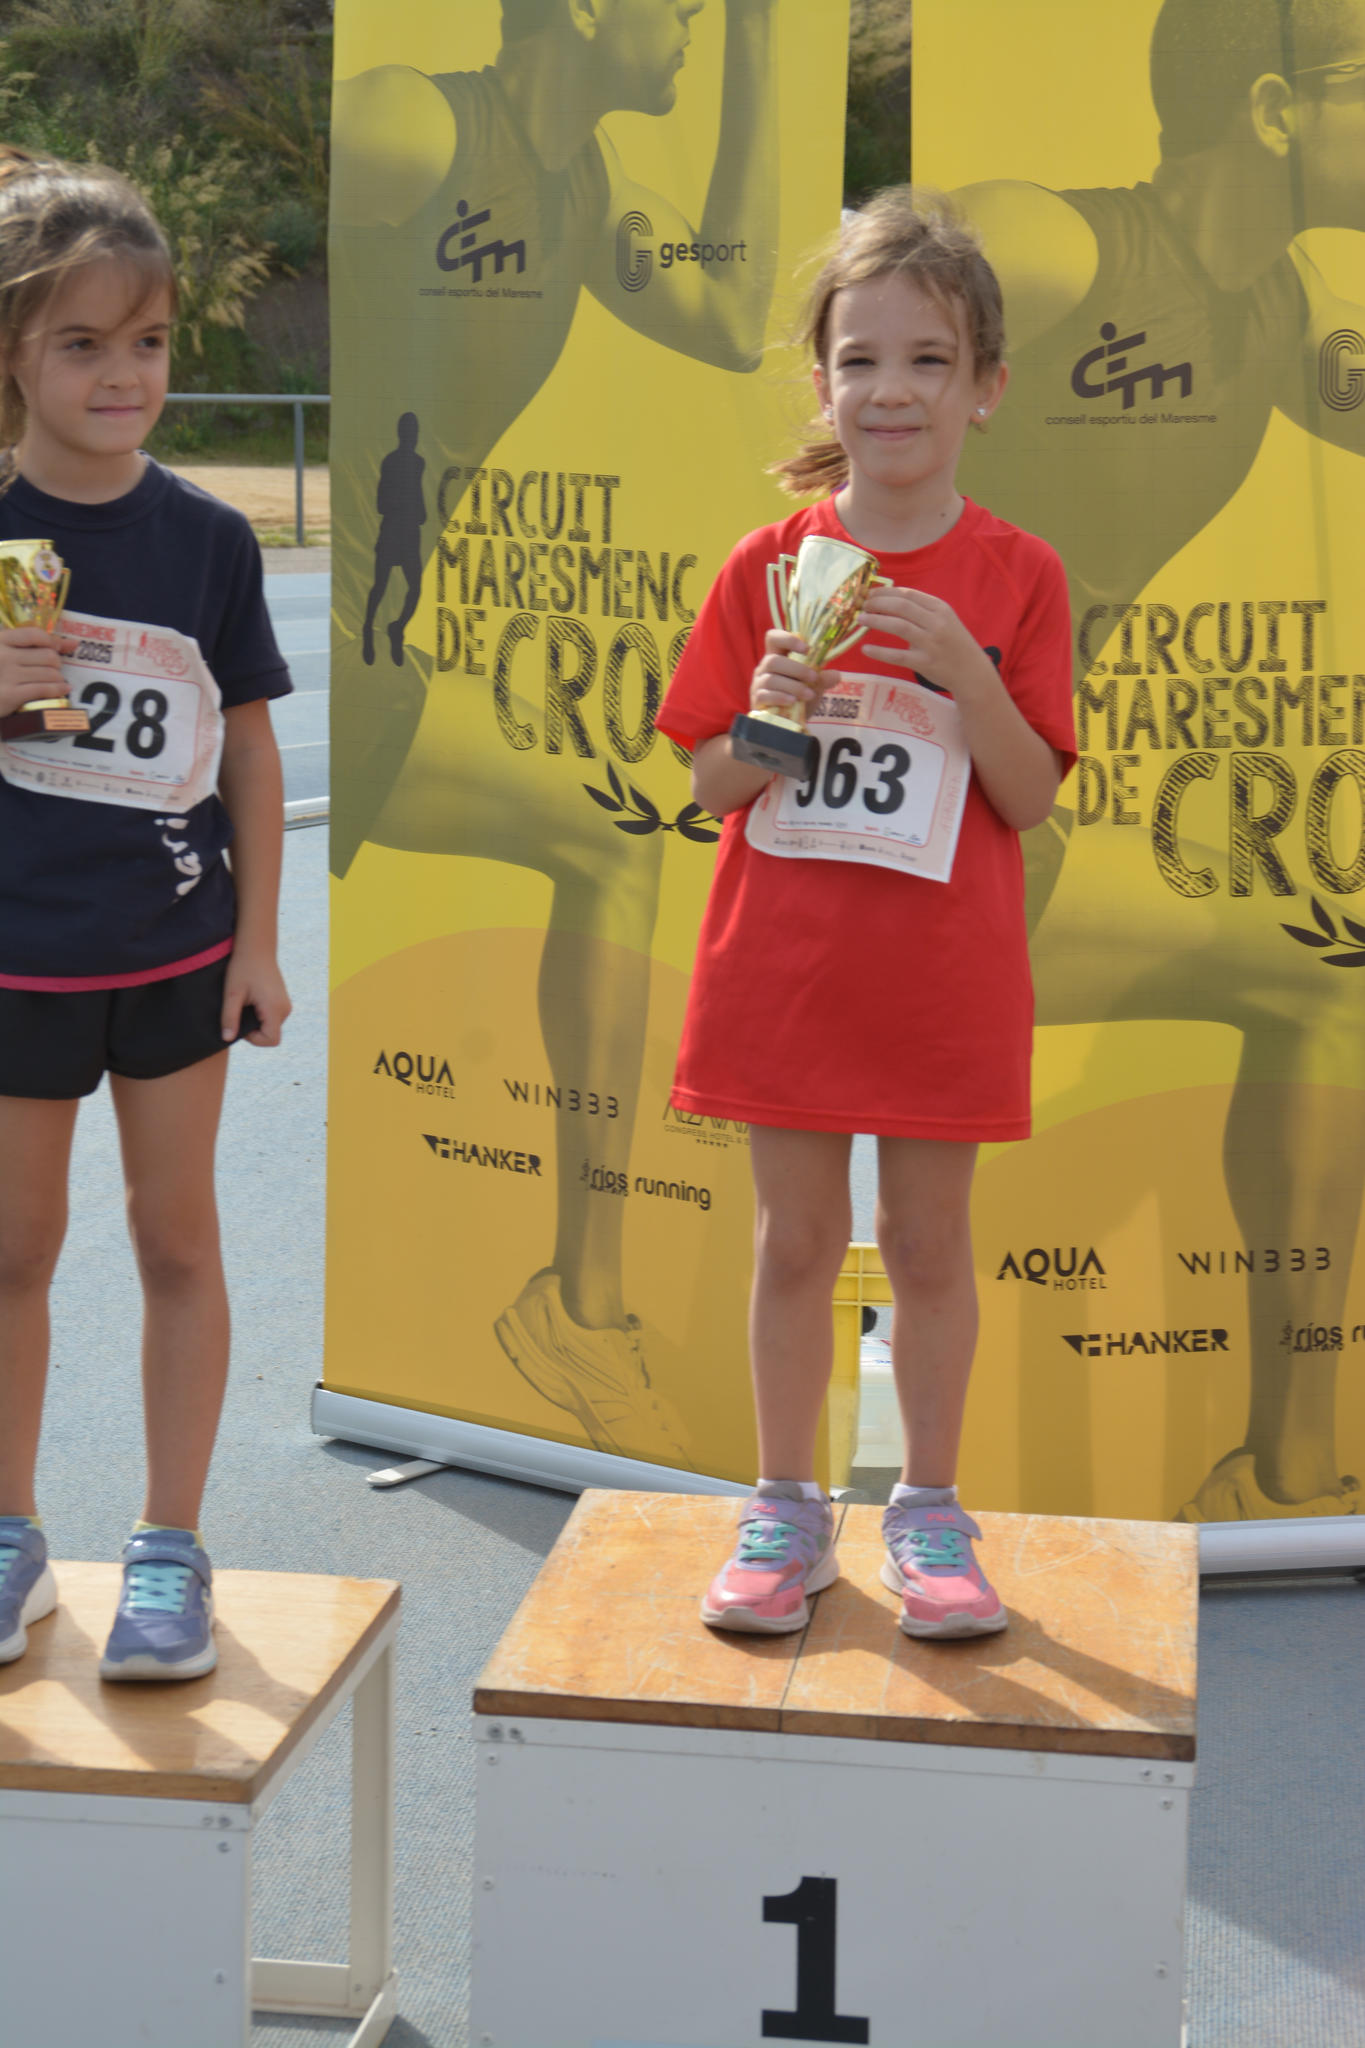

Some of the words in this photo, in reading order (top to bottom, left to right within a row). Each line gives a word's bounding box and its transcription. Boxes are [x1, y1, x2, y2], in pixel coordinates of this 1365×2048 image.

[660, 240, 747, 269] gesport
[1045, 414, 1086, 425] consell
[1089, 414, 1136, 427] esportiu
[1139, 413, 1157, 425] del
[1161, 413, 1217, 424] Maresme
[437, 466, 621, 543] CIRCUIT
[437, 536, 698, 623] MARESMENC
[77, 640, 113, 664] 2025
[436, 606, 486, 676] DE
[1078, 600, 1327, 675] CIRCUIT
[47, 681, 170, 760] 28
[1077, 754, 1141, 826] DE
[1152, 749, 1365, 898] CRO
[373, 1049, 456, 1086] AQUA
[416, 1083, 456, 1099] HOTEL
[635, 1177, 711, 1211] running
[996, 1247, 1107, 1285] AQUA
[1053, 1278, 1107, 1291] HOTEL
[752, 1503, 778, 1514] FILA
[926, 1513, 956, 1523] FILA
[761, 1875, 869, 2046] 1
